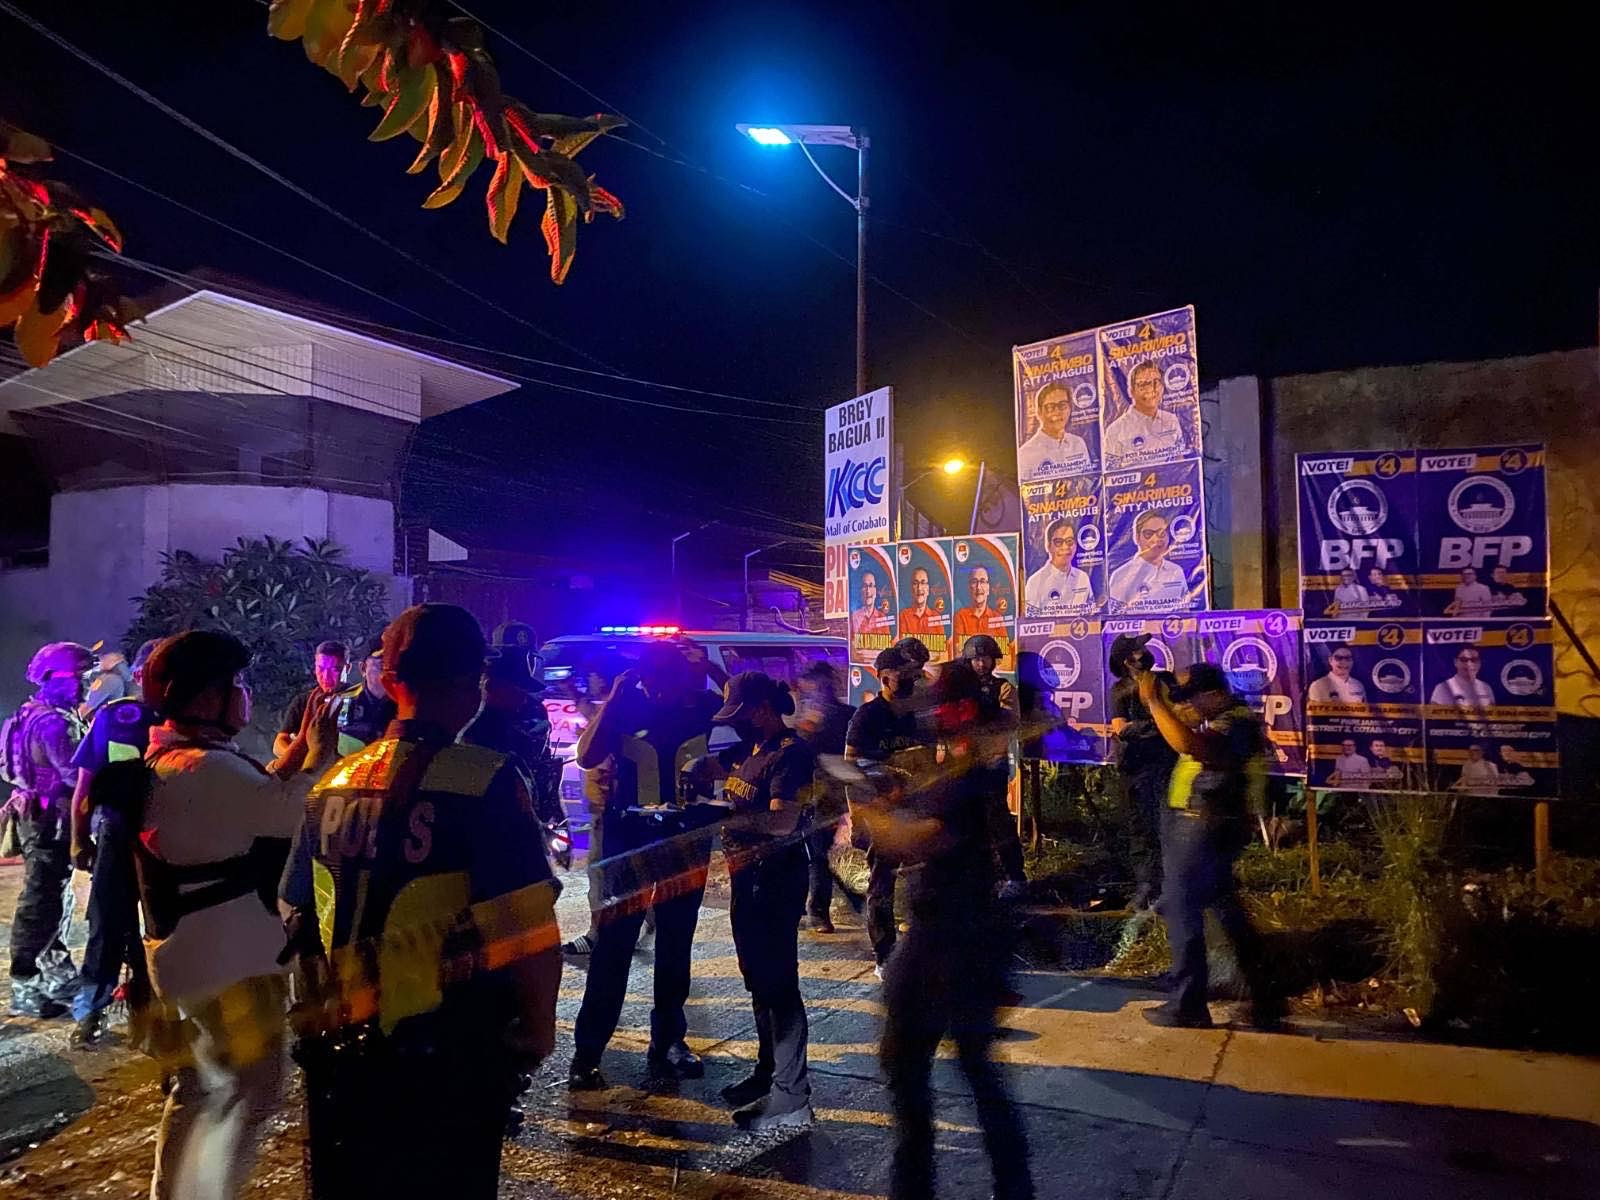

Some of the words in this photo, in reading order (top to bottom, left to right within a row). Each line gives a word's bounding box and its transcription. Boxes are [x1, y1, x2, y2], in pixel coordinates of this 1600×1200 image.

[1138, 324, 1151, 339] 4
[1050, 345, 1062, 358] 4
[1141, 344, 1187, 362] NAGUIB
[1052, 364, 1094, 380] NAGUIB
[839, 396, 873, 428] BRGY
[828, 421, 871, 454] BAGUA
[1307, 461, 1350, 473] VOTE!
[1426, 456, 1472, 470] VOTE!
[826, 456, 886, 518] KCC
[1111, 473, 1137, 485] VOTE!
[1144, 473, 1157, 487] 4
[1055, 485, 1067, 497] 4
[1113, 484, 1192, 505] SINARIMBO
[1028, 495, 1097, 515] SINARIMBO
[1147, 496, 1193, 510] NAGUIB
[1057, 505, 1099, 519] NAGUIB
[826, 522, 841, 537] Mall
[843, 521, 851, 535] of
[852, 515, 887, 533] Cotabato
[1320, 537, 1405, 571] BFP
[1438, 535, 1533, 569] BFP
[1023, 624, 1051, 634] VOTE!
[1110, 620, 1142, 631] VOTE!
[1205, 619, 1242, 631] VOTE!
[1308, 629, 1352, 641] VOTE!
[1432, 630, 1478, 642] VOTE!
[1049, 691, 1093, 718] FP
